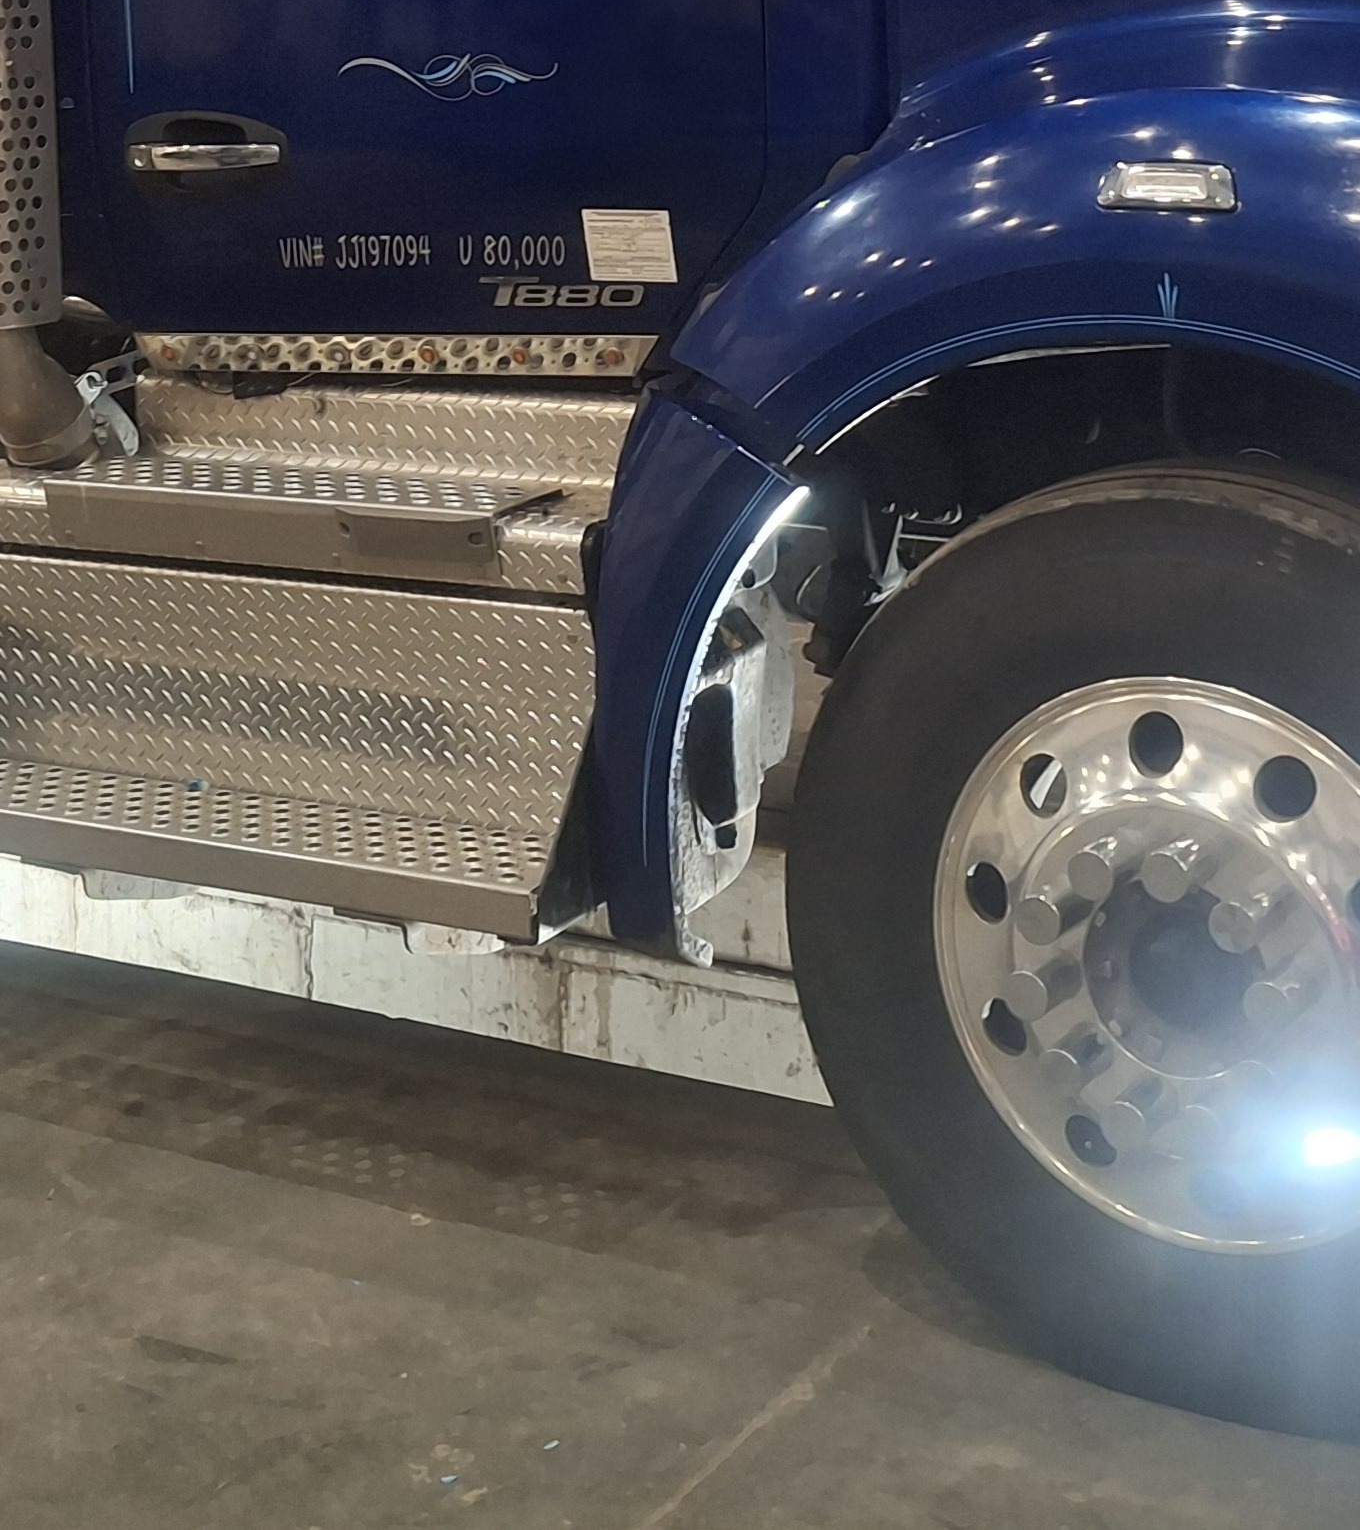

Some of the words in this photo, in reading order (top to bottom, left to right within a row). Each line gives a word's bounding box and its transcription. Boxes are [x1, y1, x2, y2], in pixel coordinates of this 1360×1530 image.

[279, 235, 325, 268] VIN#
[335, 235, 431, 269] JJ197094
[459, 235, 472, 266] U
[483, 235, 566, 271] 80,000
[478, 276, 645, 307] T880
